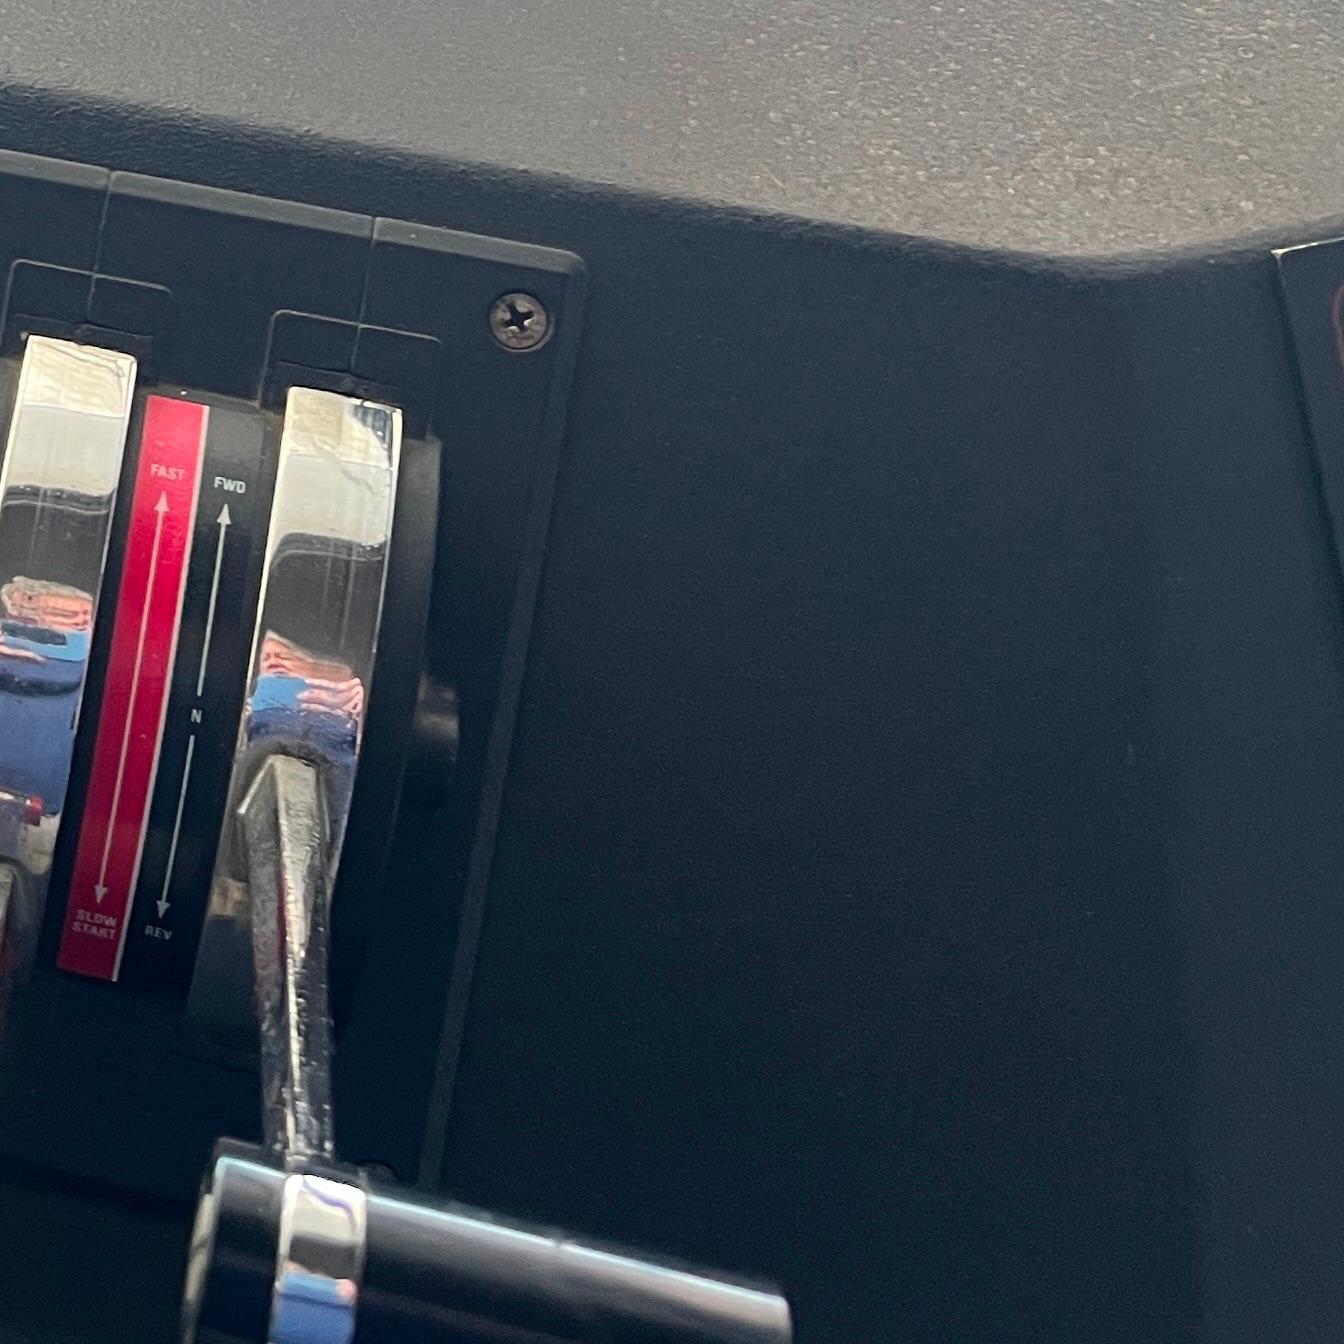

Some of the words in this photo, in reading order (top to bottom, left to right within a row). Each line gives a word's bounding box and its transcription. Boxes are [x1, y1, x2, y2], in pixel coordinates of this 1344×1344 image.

[150, 463, 186, 481] FAST
[214, 476, 246, 494] FWD
[191, 709, 201, 723] N
[75, 909, 117, 927] SLOW
[72, 921, 116, 940] START
[144, 925, 172, 940] REV
